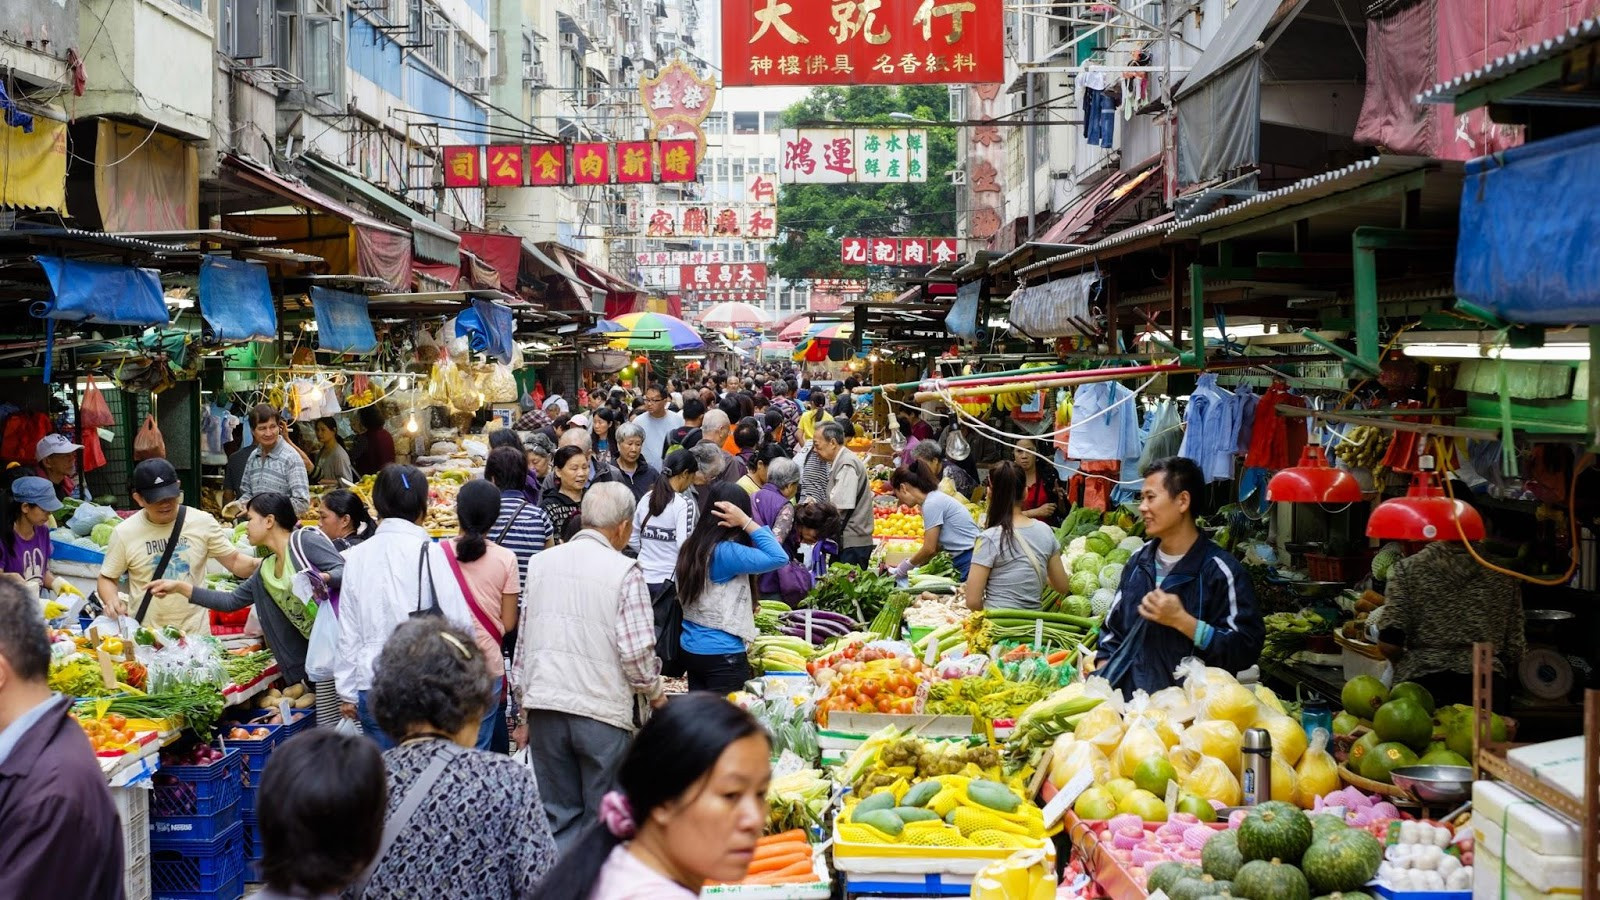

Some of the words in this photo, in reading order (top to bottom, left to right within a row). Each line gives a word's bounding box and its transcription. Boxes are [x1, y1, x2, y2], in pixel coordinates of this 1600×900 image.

[749, 54, 855, 76] 神樓佛具
[872, 53, 978, 75] 名香紙料
[784, 136, 857, 175] 鴻運
[844, 240, 956, 264] 九記肉食
